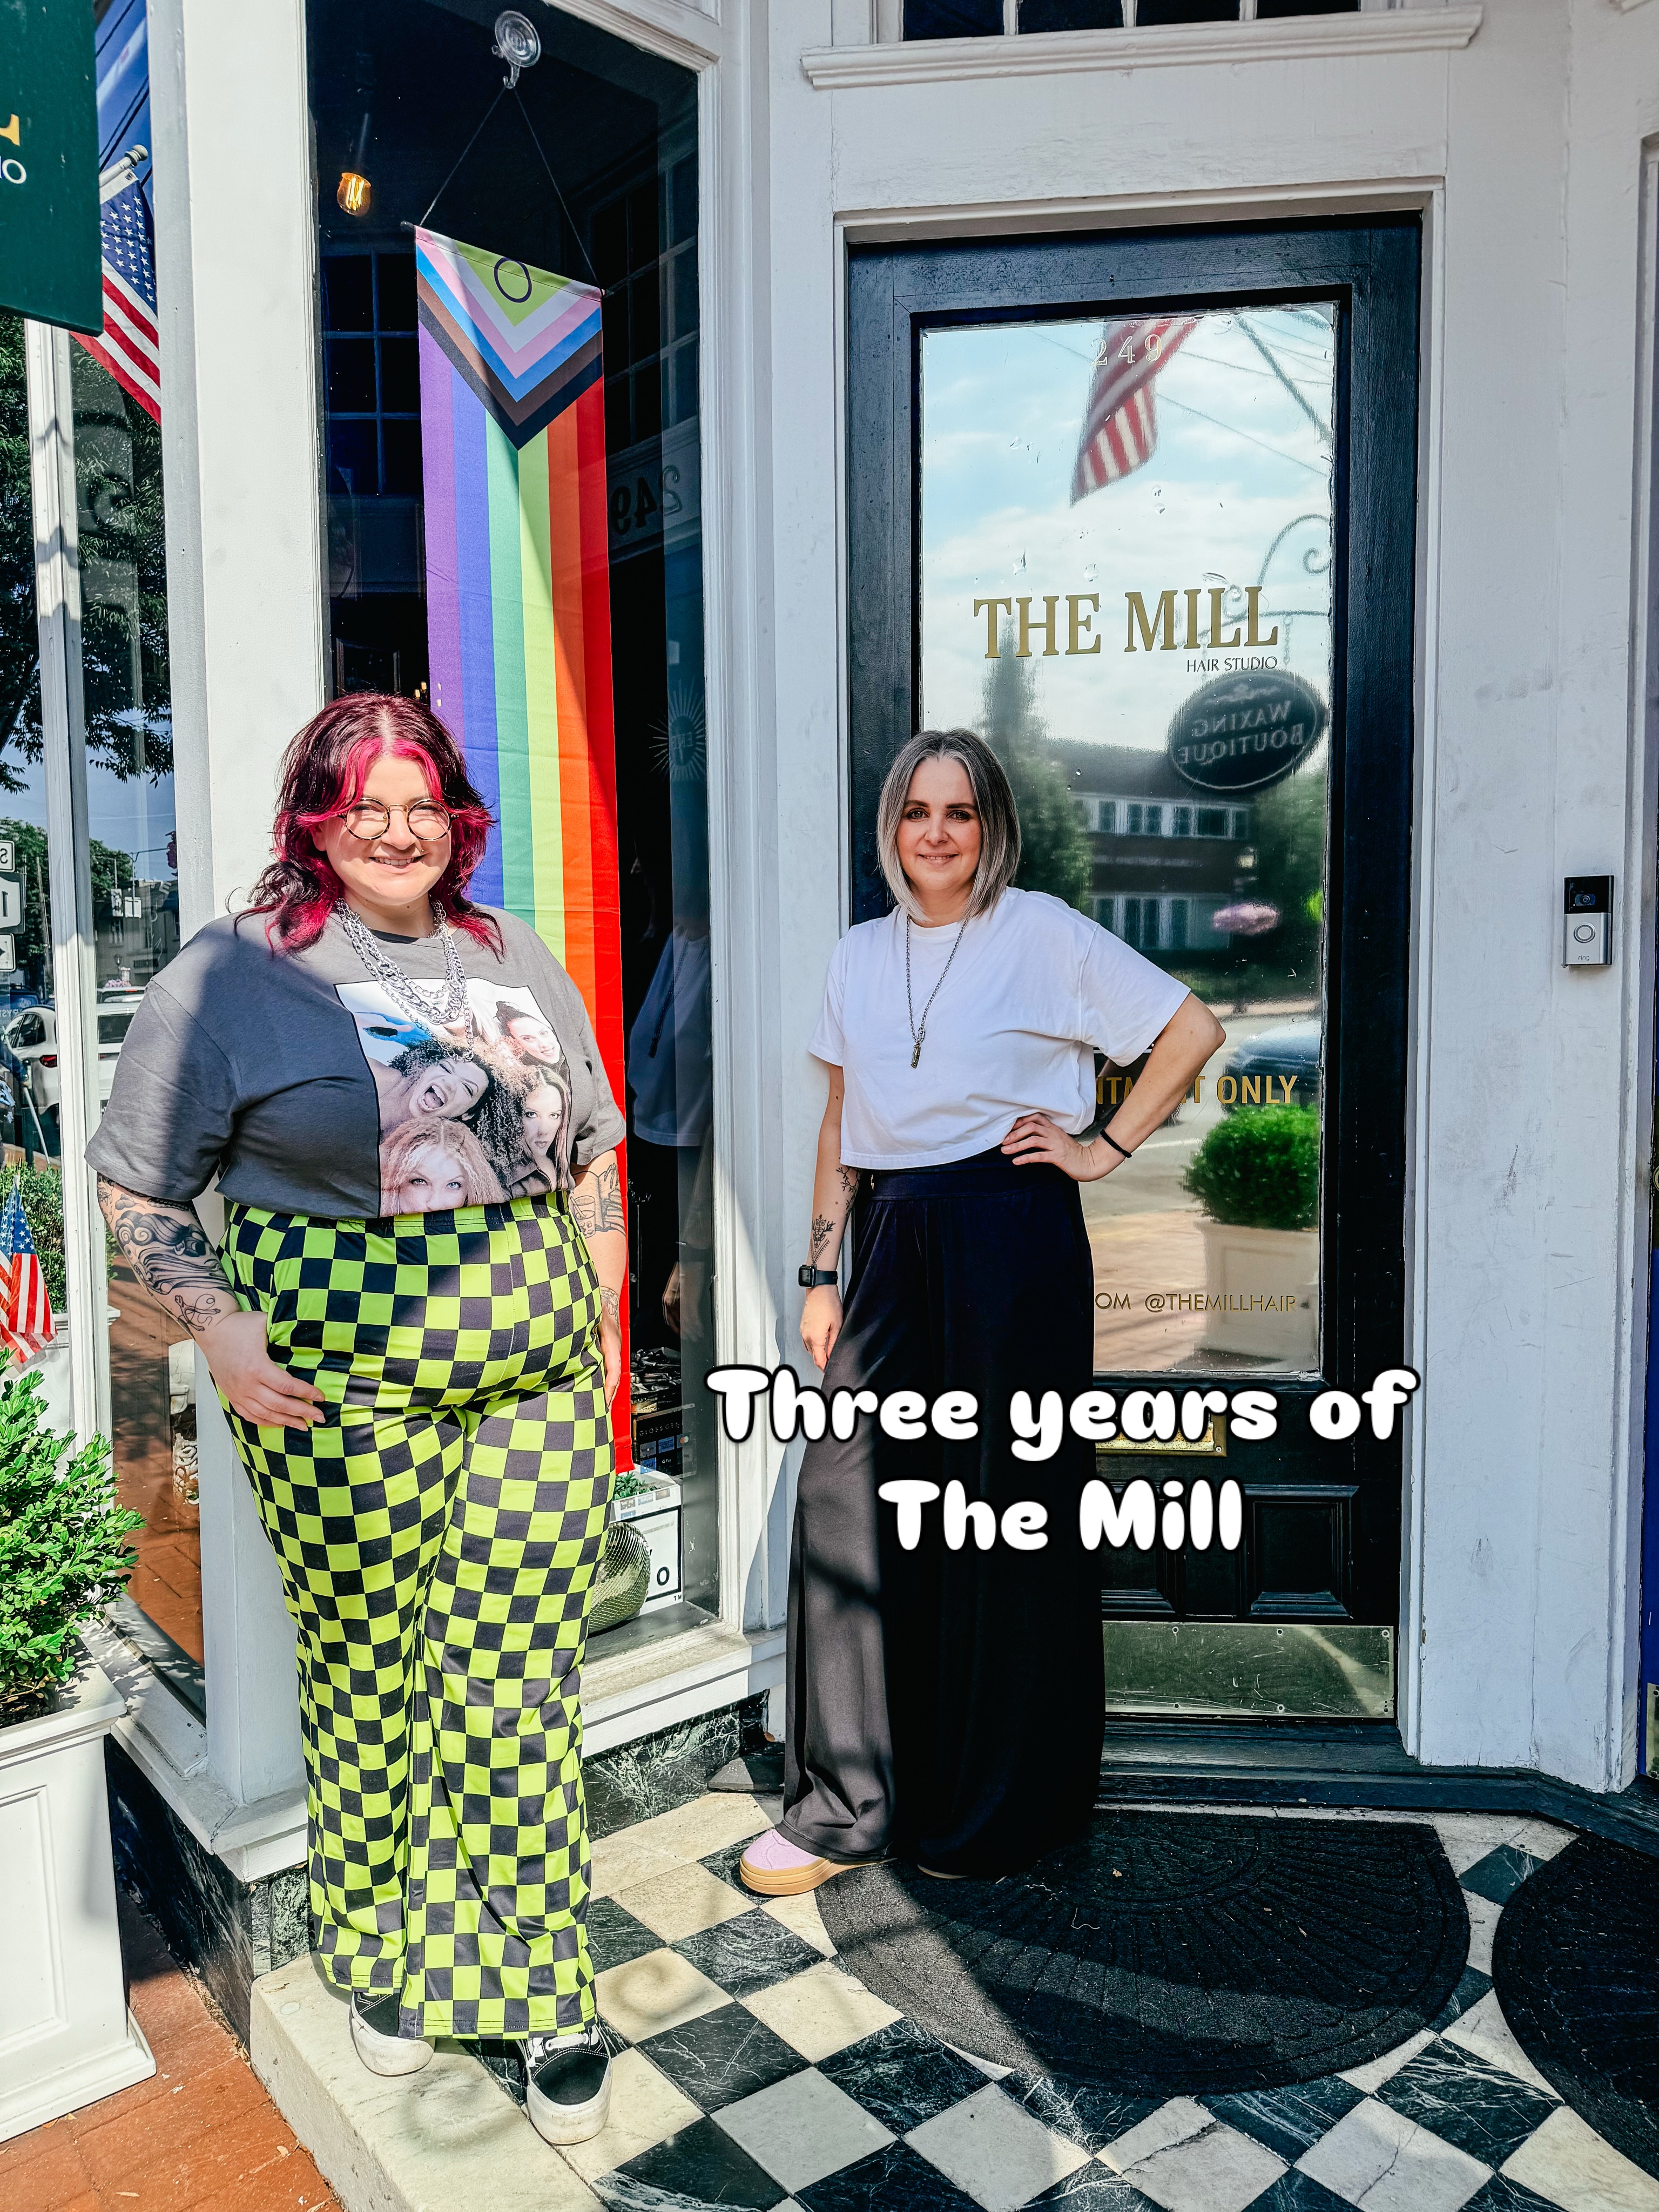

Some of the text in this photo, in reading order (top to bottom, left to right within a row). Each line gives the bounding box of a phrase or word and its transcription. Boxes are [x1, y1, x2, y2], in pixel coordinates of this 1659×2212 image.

[1090, 334, 1162, 366] 249
[974, 585, 1278, 659] THE MILL
[1187, 656, 1278, 672] HAIR STUDIO
[1217, 1075, 1298, 1104] ONLY
[1145, 1293, 1296, 1313] @THEMILLHAIR
